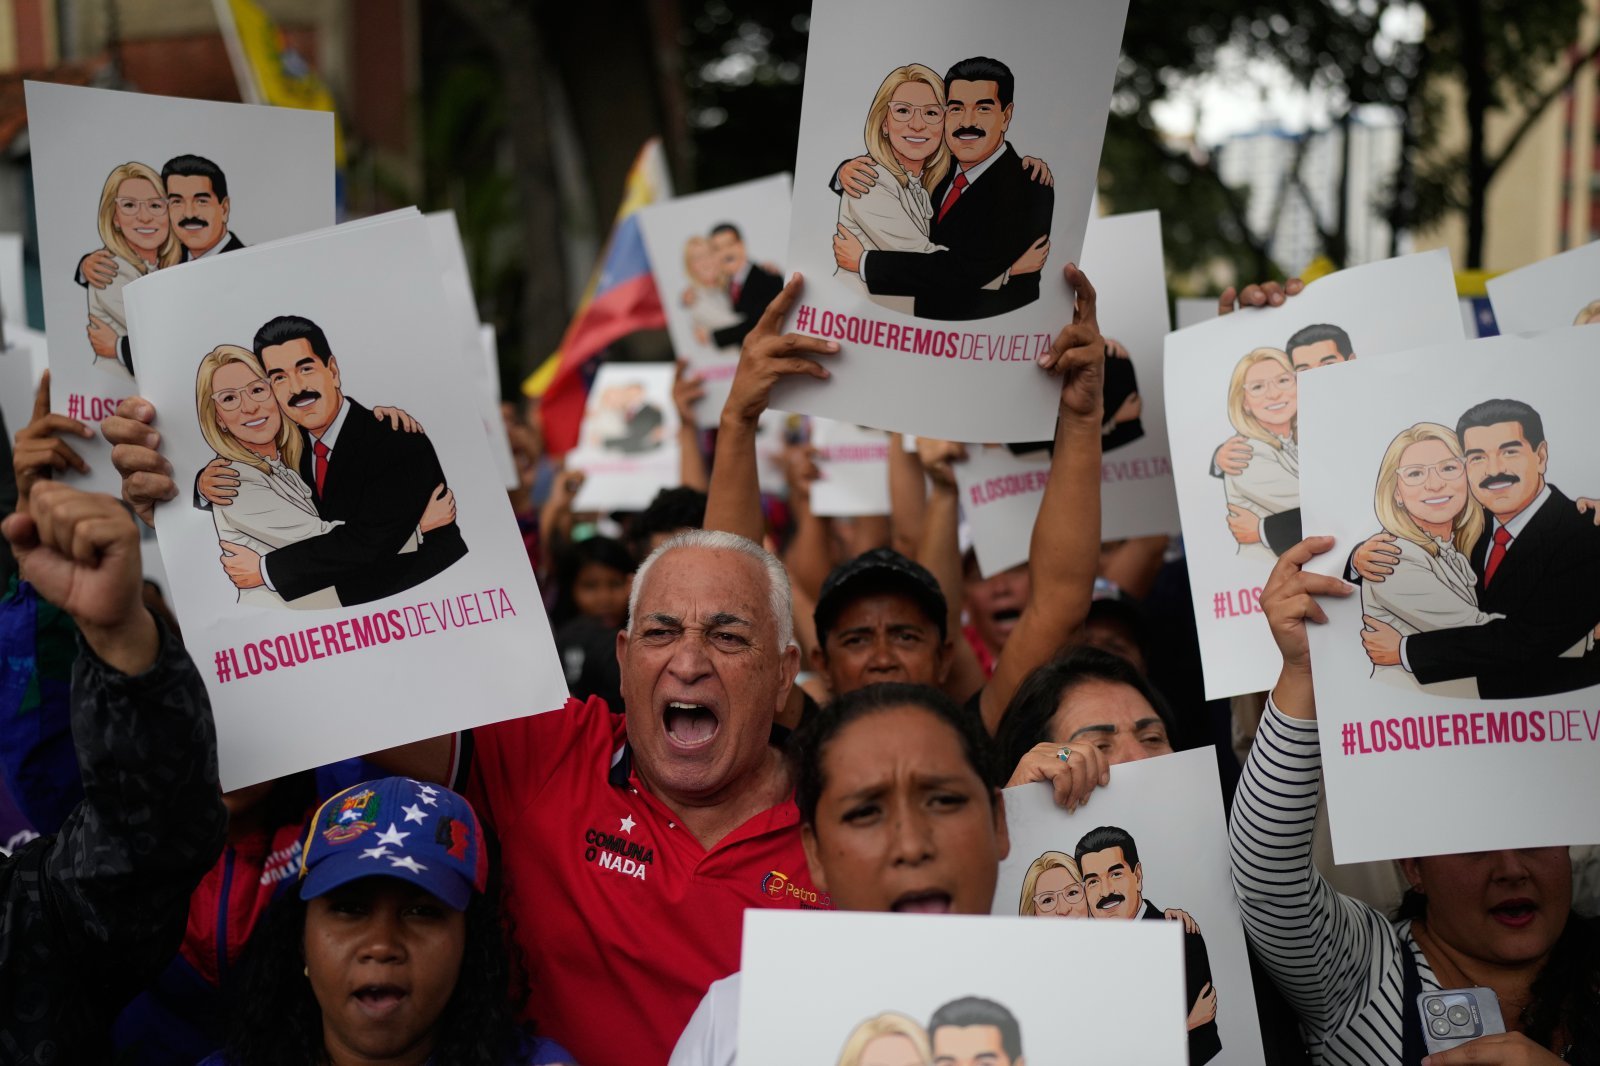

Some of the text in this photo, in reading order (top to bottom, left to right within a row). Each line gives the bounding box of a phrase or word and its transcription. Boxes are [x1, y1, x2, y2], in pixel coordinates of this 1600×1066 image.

[796, 304, 1051, 362] #LOSQUEREMOSDEVUELTA
[68, 393, 124, 421] #LOS
[214, 587, 517, 684] #LOSQUEREMOSDEVUELTA
[1341, 710, 1600, 756] #LOSQUEREMOSDEV
[585, 828, 654, 865] COMUNA
[585, 846, 646, 881] O NADA
